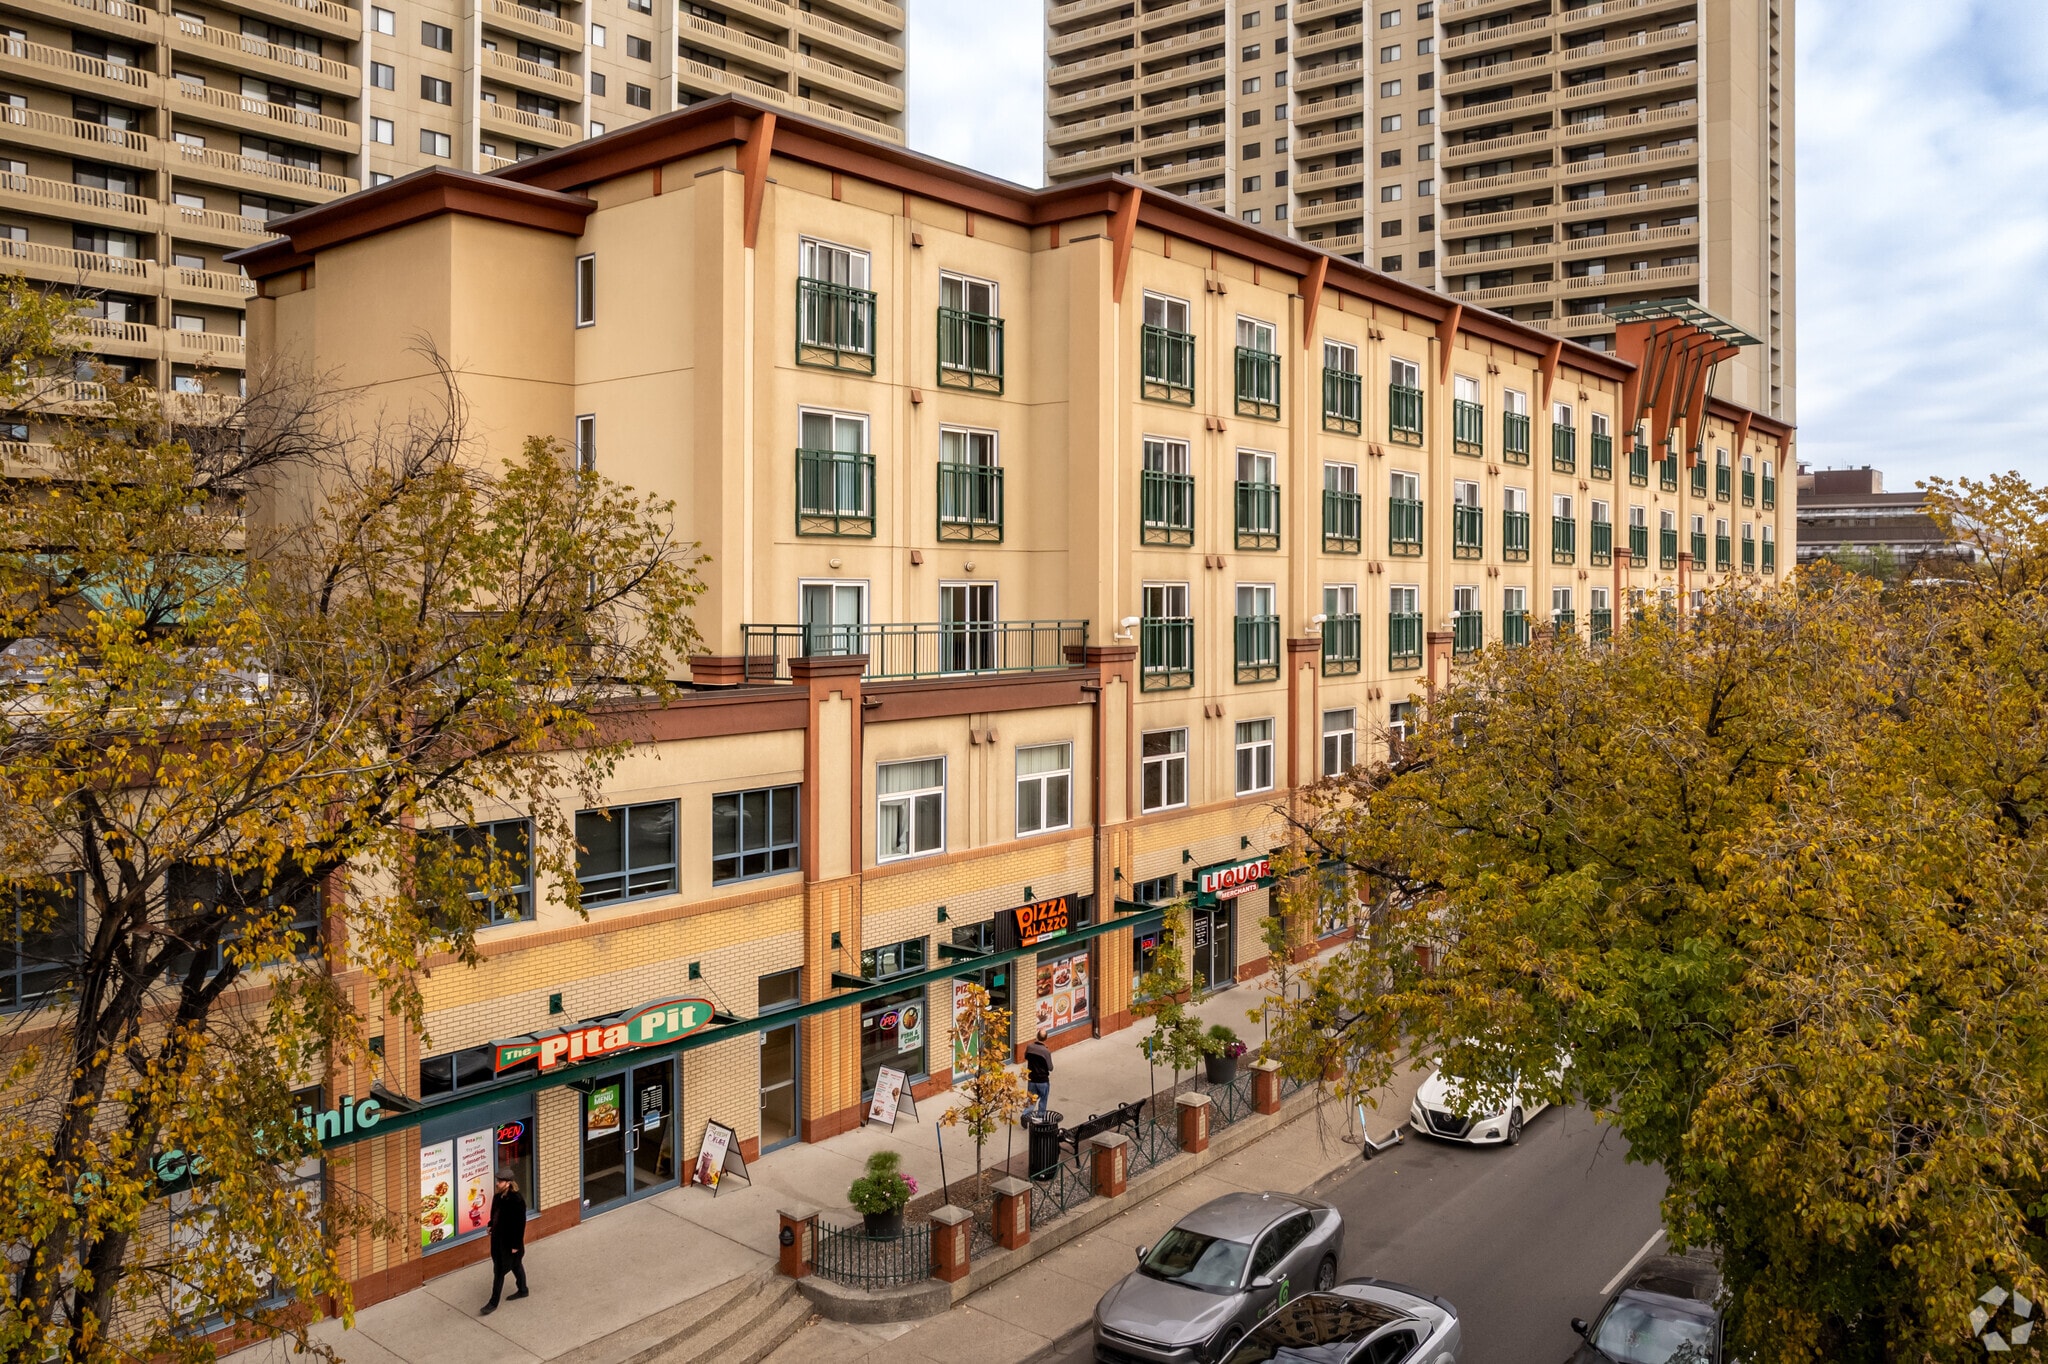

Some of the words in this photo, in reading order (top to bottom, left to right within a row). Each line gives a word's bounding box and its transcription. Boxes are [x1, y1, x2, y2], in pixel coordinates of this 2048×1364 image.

[1203, 860, 1271, 892] LIQUOR
[1221, 884, 1257, 899] MERCHANTS
[1016, 898, 1068, 934] PIZZA
[504, 1047, 531, 1060] The
[541, 1025, 629, 1067] Pita
[641, 1006, 697, 1041] Pit
[594, 1094, 614, 1105] MENU
